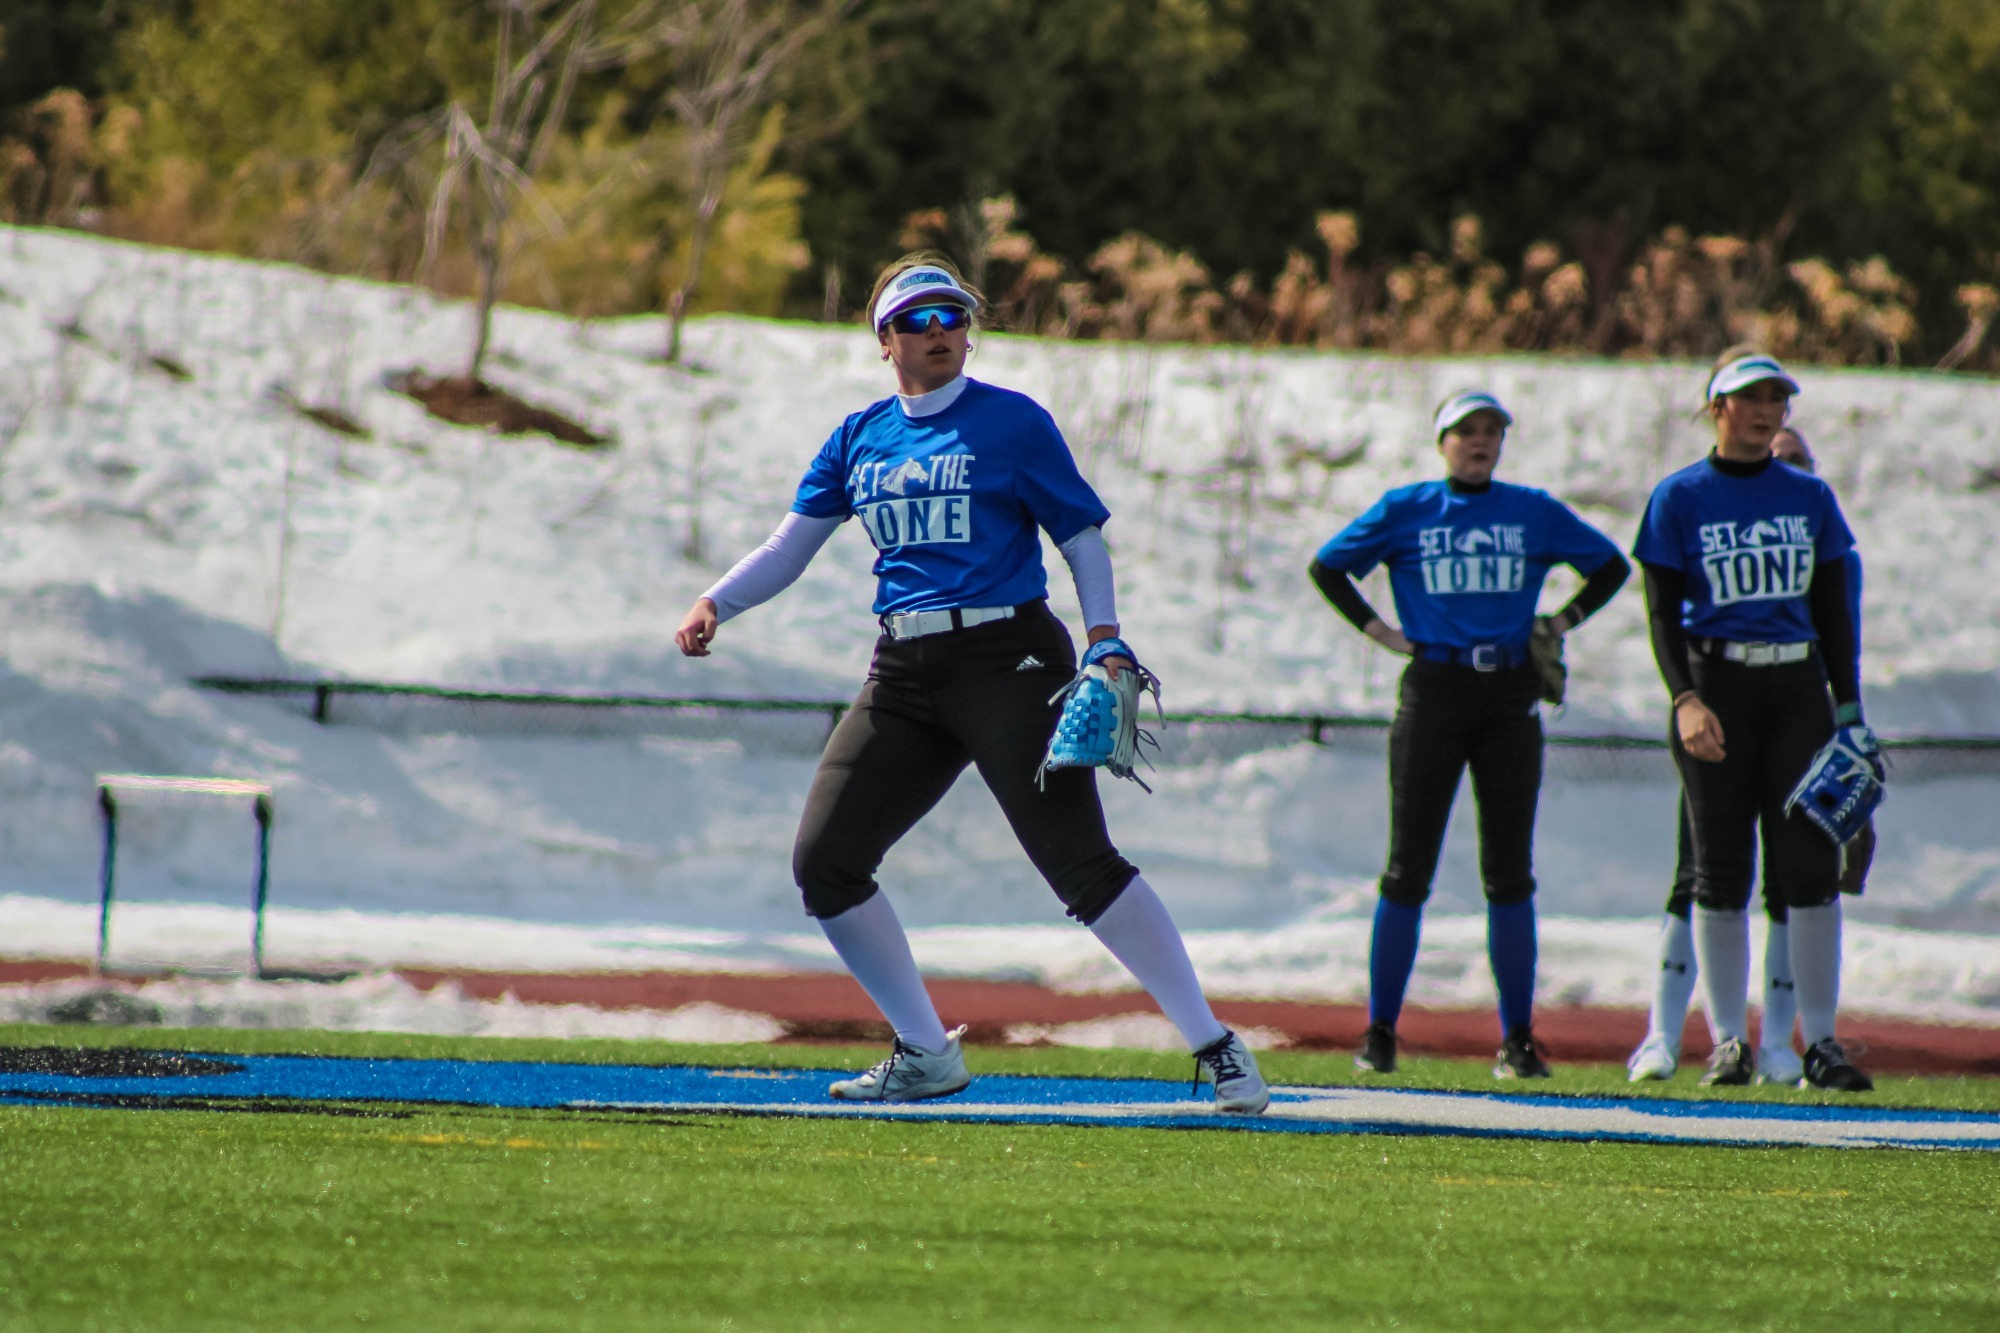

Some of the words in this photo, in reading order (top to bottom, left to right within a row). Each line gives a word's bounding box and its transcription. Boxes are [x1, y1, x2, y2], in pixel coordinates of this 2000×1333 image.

[849, 461, 887, 501] SET
[928, 454, 976, 491] THE
[1418, 526, 1454, 557] SET
[1489, 524, 1526, 554] THE
[1699, 520, 1738, 553] SET
[1772, 515, 1814, 543] THE
[1426, 556, 1523, 592] TONE
[1707, 548, 1811, 599] TONE
